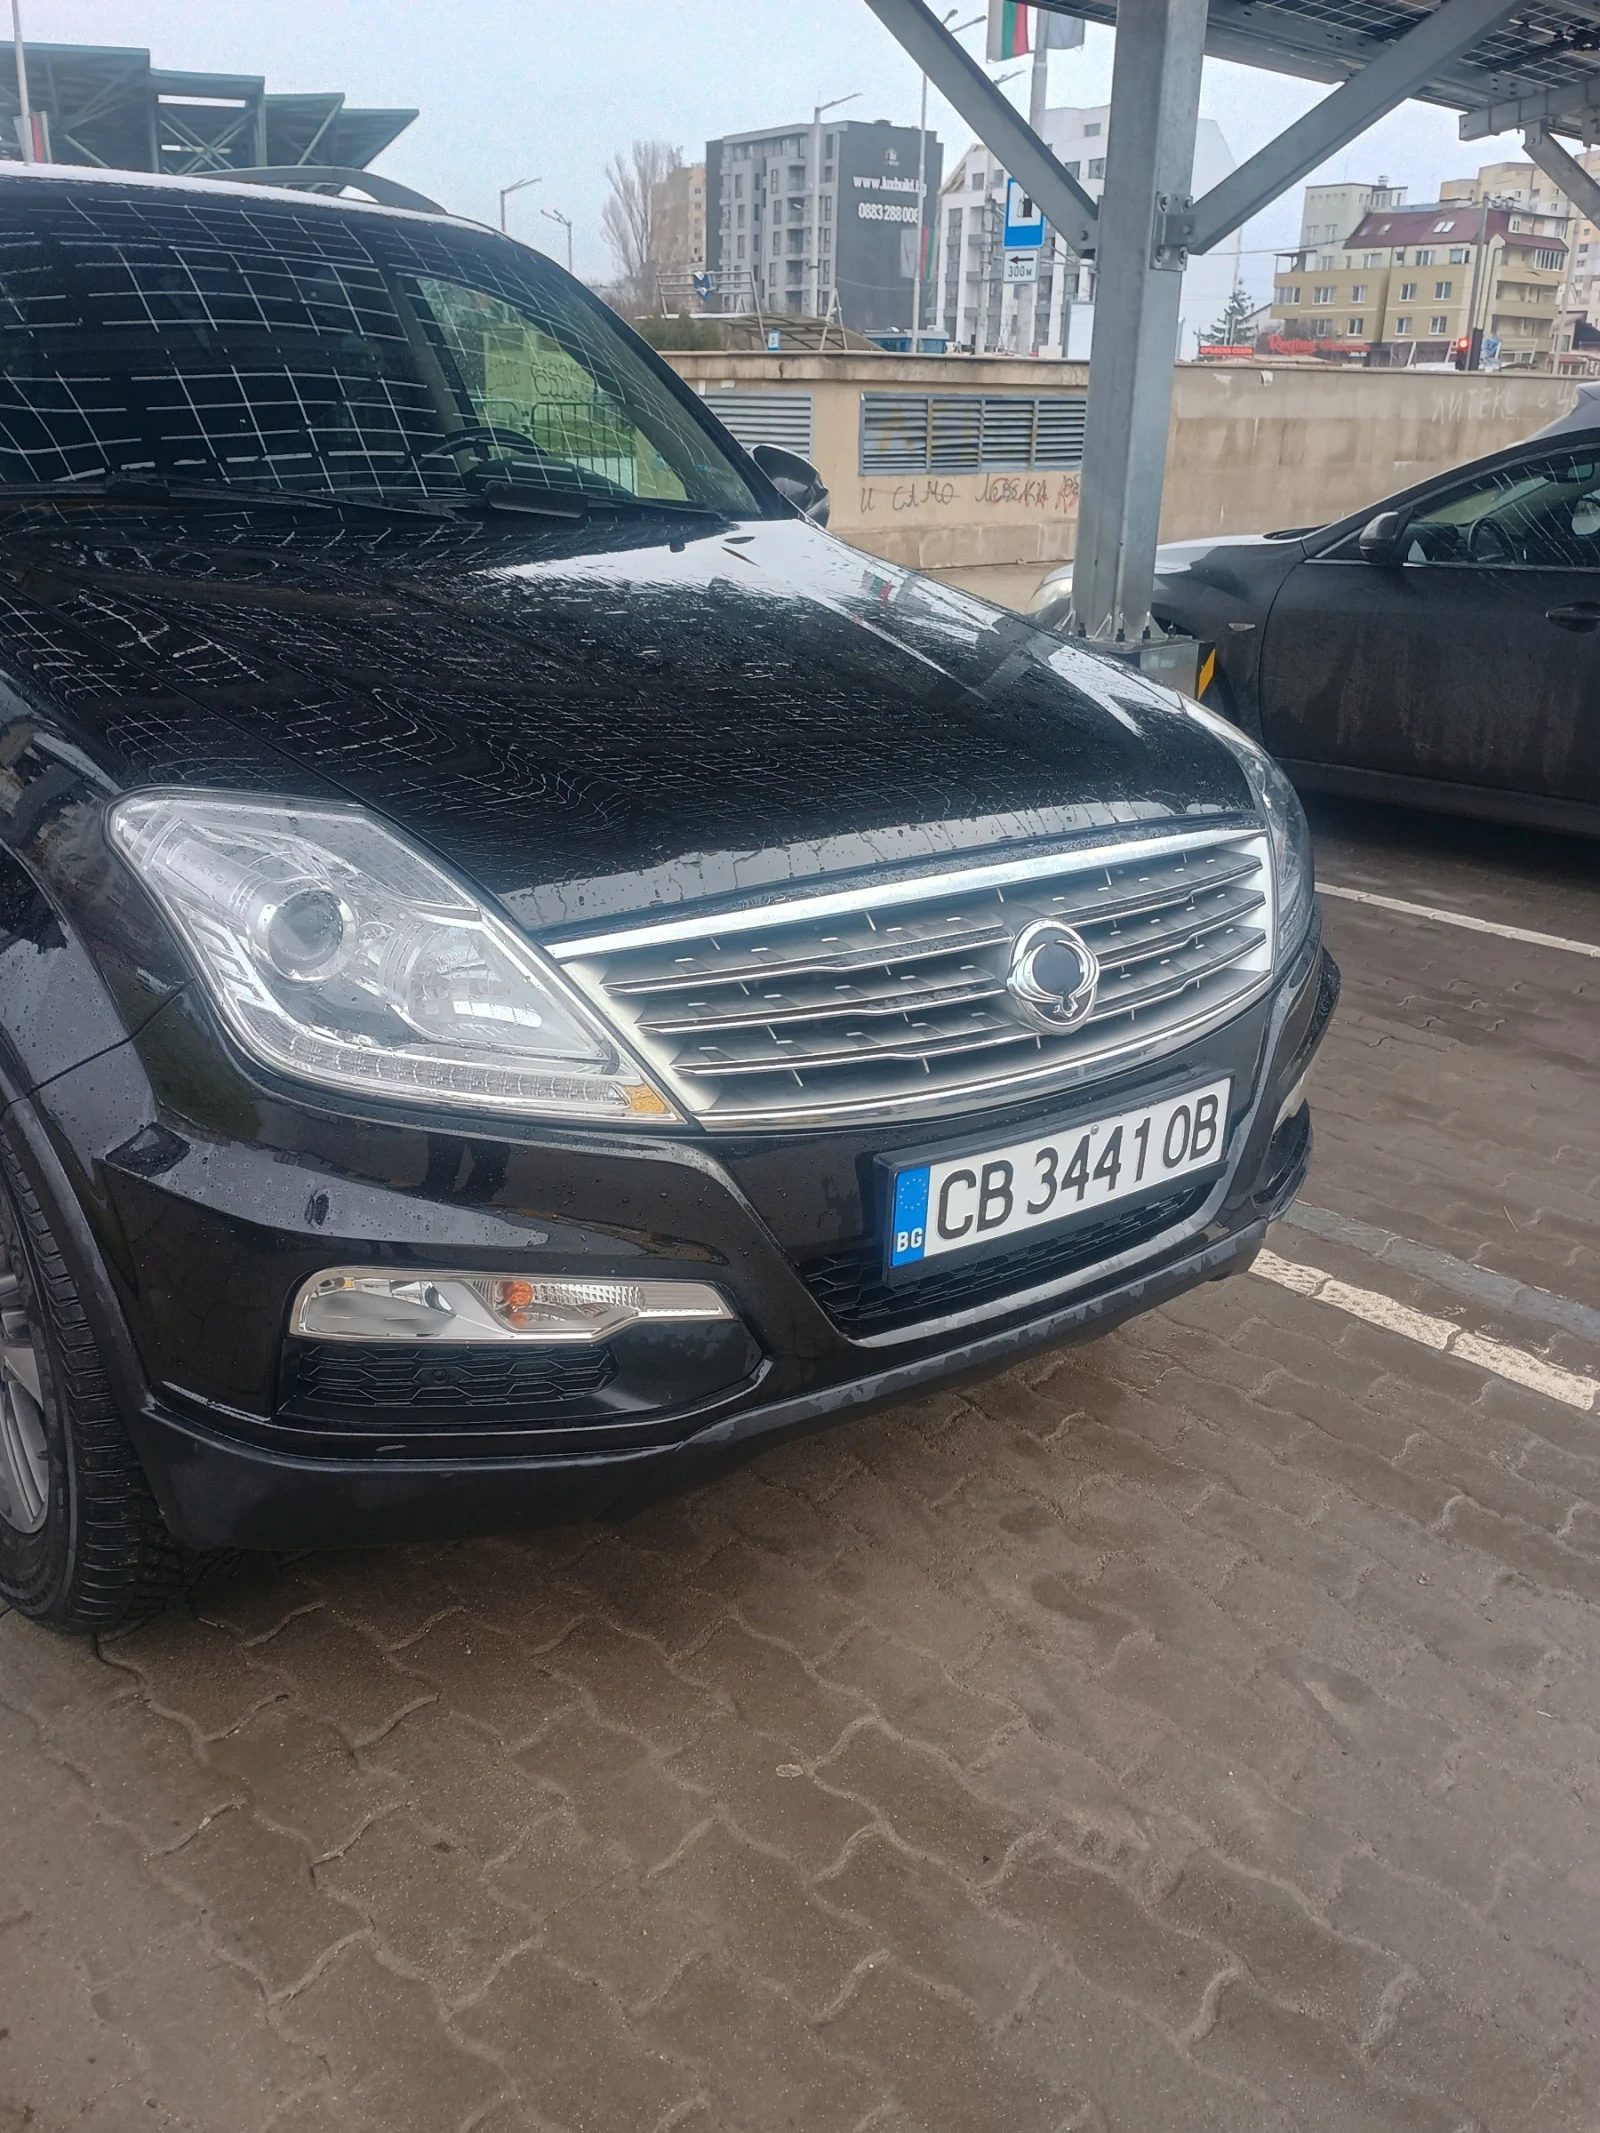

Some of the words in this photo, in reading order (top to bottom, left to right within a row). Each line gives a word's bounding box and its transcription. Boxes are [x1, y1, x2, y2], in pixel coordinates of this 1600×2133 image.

[858, 202, 883, 220] 0883
[884, 205, 901, 221] 288
[936, 1159, 1014, 1240] CB
[1026, 1116, 1152, 1215] 3441
[1163, 1093, 1219, 1169] OB
[897, 1227, 923, 1252] BG
